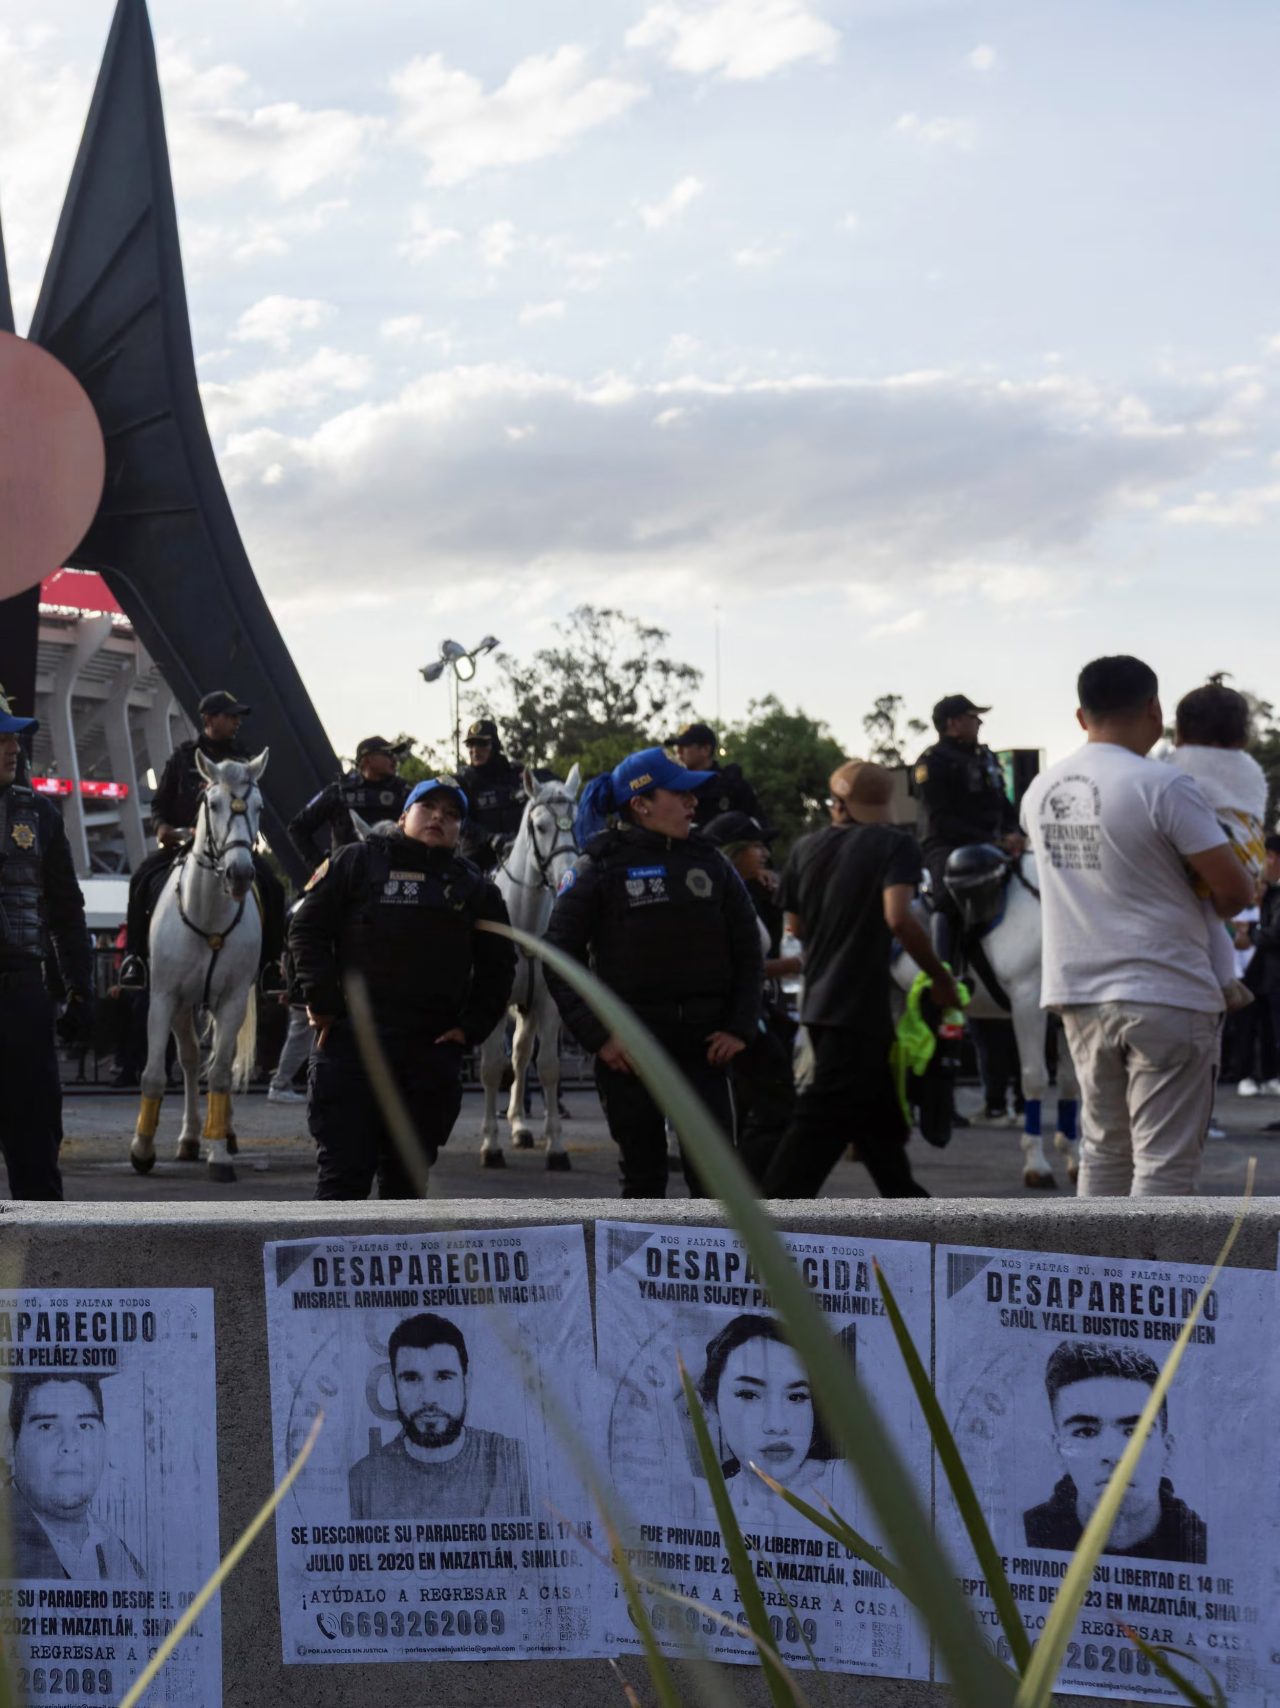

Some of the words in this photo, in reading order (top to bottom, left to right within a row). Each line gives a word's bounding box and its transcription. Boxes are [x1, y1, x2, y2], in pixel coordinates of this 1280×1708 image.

[326, 1244, 344, 1253] NOS
[352, 1242, 389, 1252] FALTAS
[396, 1239, 413, 1252] TÚ,
[421, 1241, 439, 1250] NOS
[446, 1240, 483, 1249] FALTAN
[489, 1238, 521, 1247] TODOS
[660, 1235, 680, 1244] NOS
[687, 1237, 725, 1248] FALTAS
[831, 1246, 865, 1256] TODOS
[313, 1250, 529, 1287] DESAPARECIDO
[1001, 1259, 1021, 1270] NOS
[1029, 1262, 1069, 1274] FALTAS
[1104, 1268, 1122, 1278] NOS
[1130, 1272, 1171, 1283] FALTAN
[25, 1296, 42, 1308] TÚ,
[50, 1298, 68, 1307] NOS
[76, 1299, 113, 1307] FALTAN
[119, 1299, 151, 1308] TODOS
[293, 1290, 350, 1310] MISRAEL
[354, 1289, 419, 1308] ARMANDO
[423, 1285, 495, 1306] SEPÚLVEDA
[638, 1280, 699, 1304] YAJAIRA
[704, 1284, 747, 1306] SUJEY
[987, 1272, 1219, 1322] DESAPARECIDO
[1000, 1306, 1037, 1330] SAÚL
[1042, 1312, 1077, 1333] YAEL
[1083, 1318, 1139, 1338] BUSTOS
[29, 1344, 78, 1366] PELÁEZ
[82, 1348, 117, 1366] SOTO
[291, 1526, 308, 1544] SE
[312, 1526, 390, 1544] DESCONOCE
[395, 1525, 412, 1543] SU
[416, 1524, 487, 1542] PARADERO
[491, 1523, 533, 1541] DESDE
[538, 1522, 554, 1541] EL
[640, 1524, 663, 1543] FUE
[666, 1526, 721, 1548] PRIVADA
[765, 1535, 823, 1557] LIBERTAD
[827, 1541, 841, 1559] EL
[306, 1554, 344, 1572] JULIO
[349, 1553, 373, 1571] DEL
[378, 1553, 414, 1571] 2020
[419, 1552, 435, 1571] EN
[440, 1547, 518, 1571] MAZATLÁN,
[521, 1549, 583, 1568] SINALOA.
[694, 1555, 717, 1574] DEL
[1012, 1558, 1068, 1579] PRIVADO
[777, 1559, 849, 1587] MAZATLÁN,
[1093, 1565, 1111, 1583] SU
[1115, 1568, 1174, 1591] LIBERTAD
[1179, 1574, 1193, 1592] EL
[1197, 1575, 1213, 1593] 14
[1216, 1578, 1234, 1596] DE
[17, 1589, 35, 1607] SU
[39, 1590, 108, 1609] PARADERO
[113, 1590, 154, 1609] DESDE
[301, 1584, 386, 1611] ¡AYÚDALO
[398, 1589, 408, 1602] A
[420, 1587, 507, 1602] REGRESAR
[518, 1588, 529, 1601] A
[712, 1587, 723, 1601] A
[833, 1599, 844, 1612] A
[1106, 1592, 1123, 1610] EN
[1127, 1595, 1201, 1621] MAZATLÁN,
[3, 1617, 36, 1635] 2021
[41, 1617, 57, 1636] EN
[62, 1614, 137, 1638] MAZATLÁN,
[340, 1609, 505, 1638] 6693262089
[1186, 1632, 1197, 1646] A
[30, 1646, 116, 1660] REGRESAR
[127, 1648, 137, 1660] A
